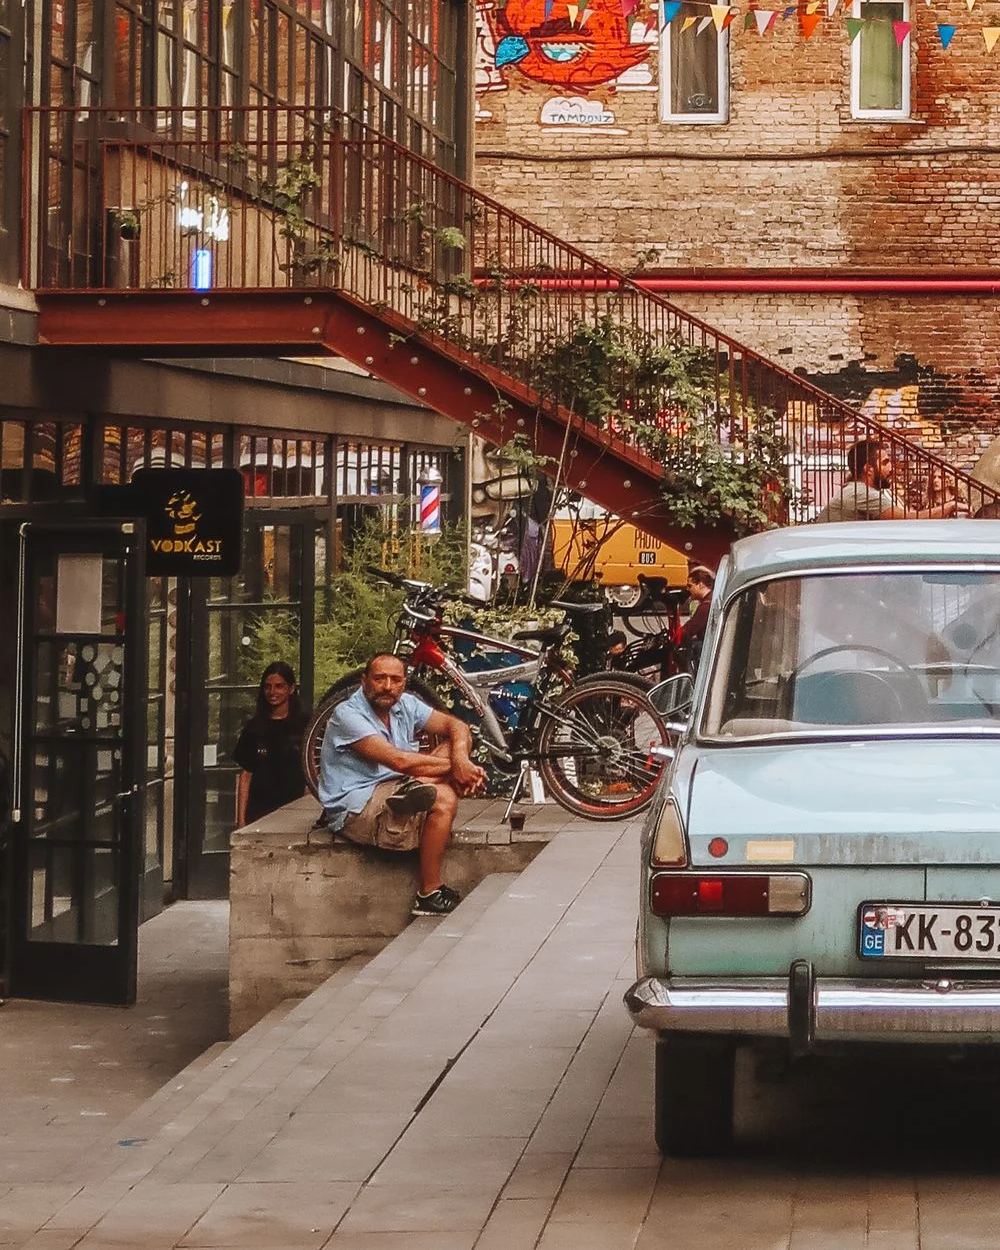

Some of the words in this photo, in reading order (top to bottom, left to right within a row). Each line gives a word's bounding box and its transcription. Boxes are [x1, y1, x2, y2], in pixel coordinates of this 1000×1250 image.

[151, 534, 222, 553] VODKAST
[641, 553, 655, 564] BUS
[864, 934, 883, 949] GE
